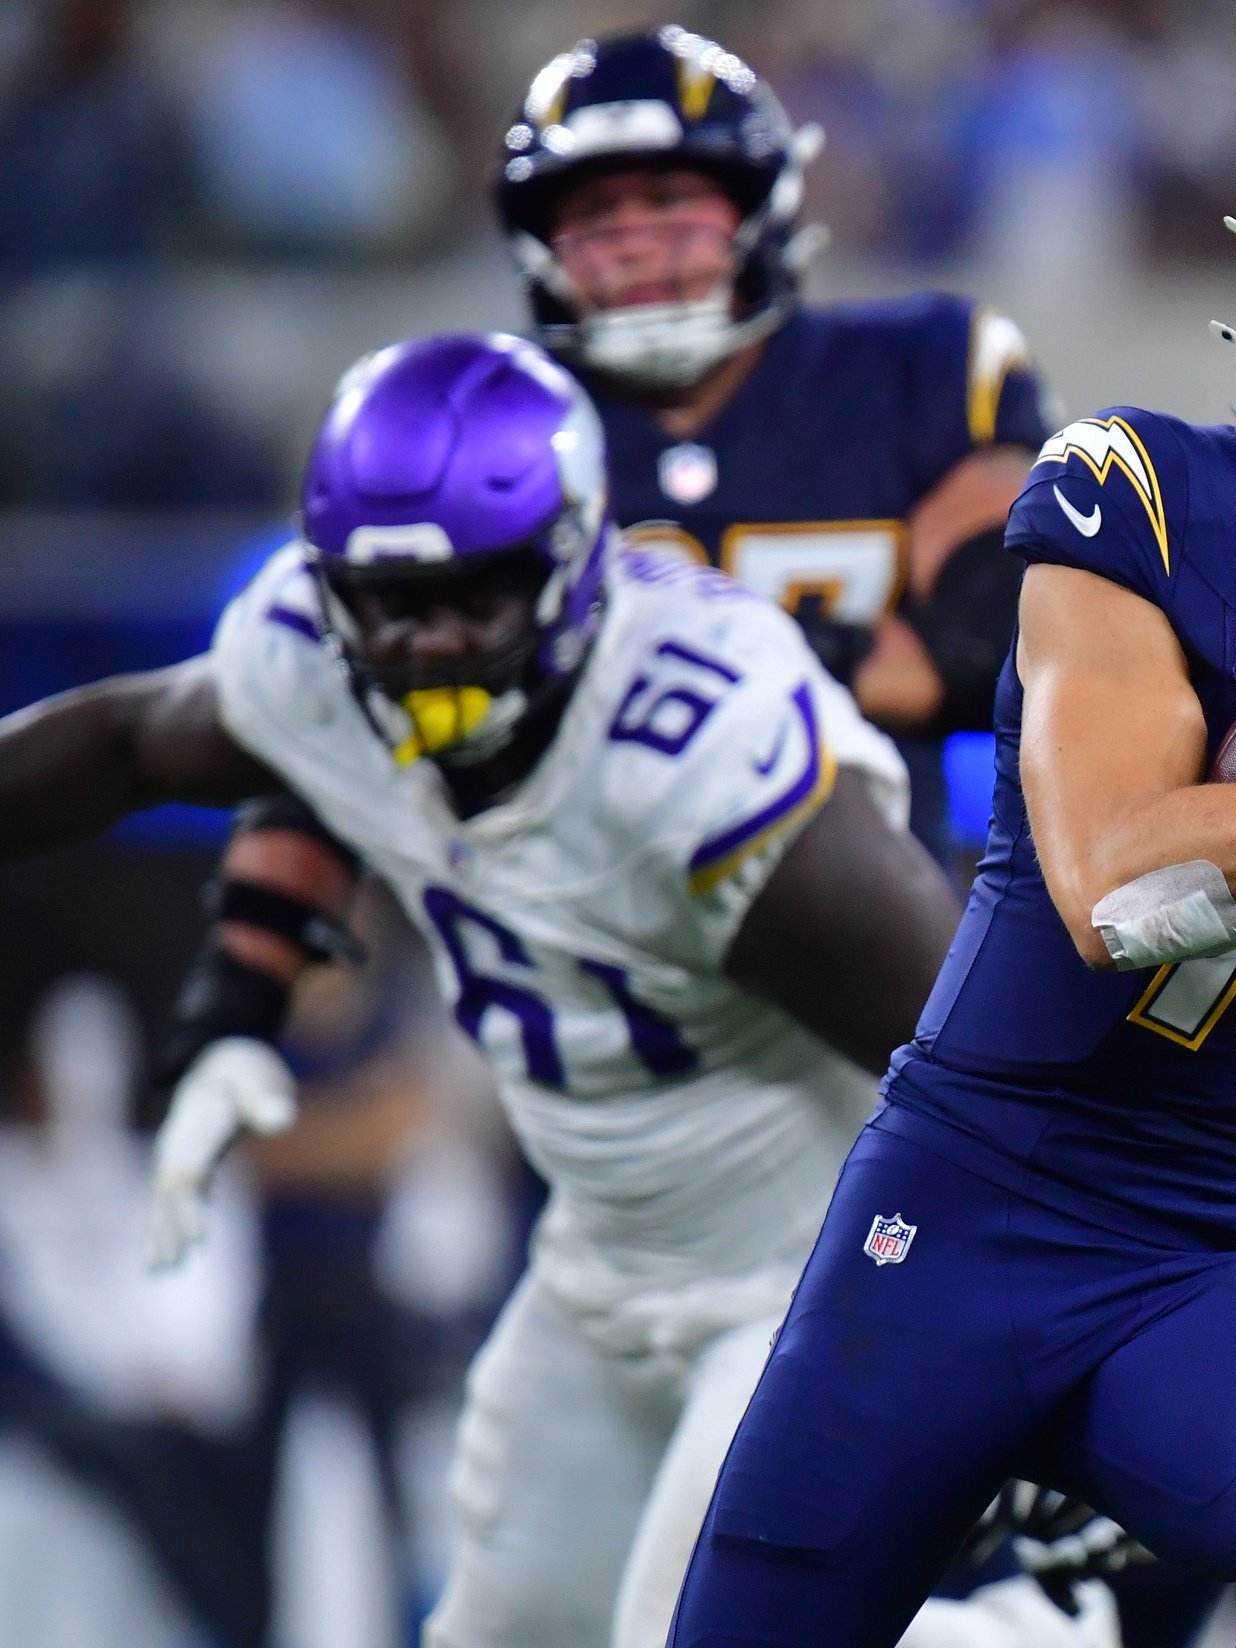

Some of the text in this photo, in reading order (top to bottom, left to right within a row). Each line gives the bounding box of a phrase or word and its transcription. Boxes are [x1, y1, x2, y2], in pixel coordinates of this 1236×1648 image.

[608, 640, 744, 755] 61
[422, 885, 700, 1088] 61
[872, 1234, 901, 1256] NFL
